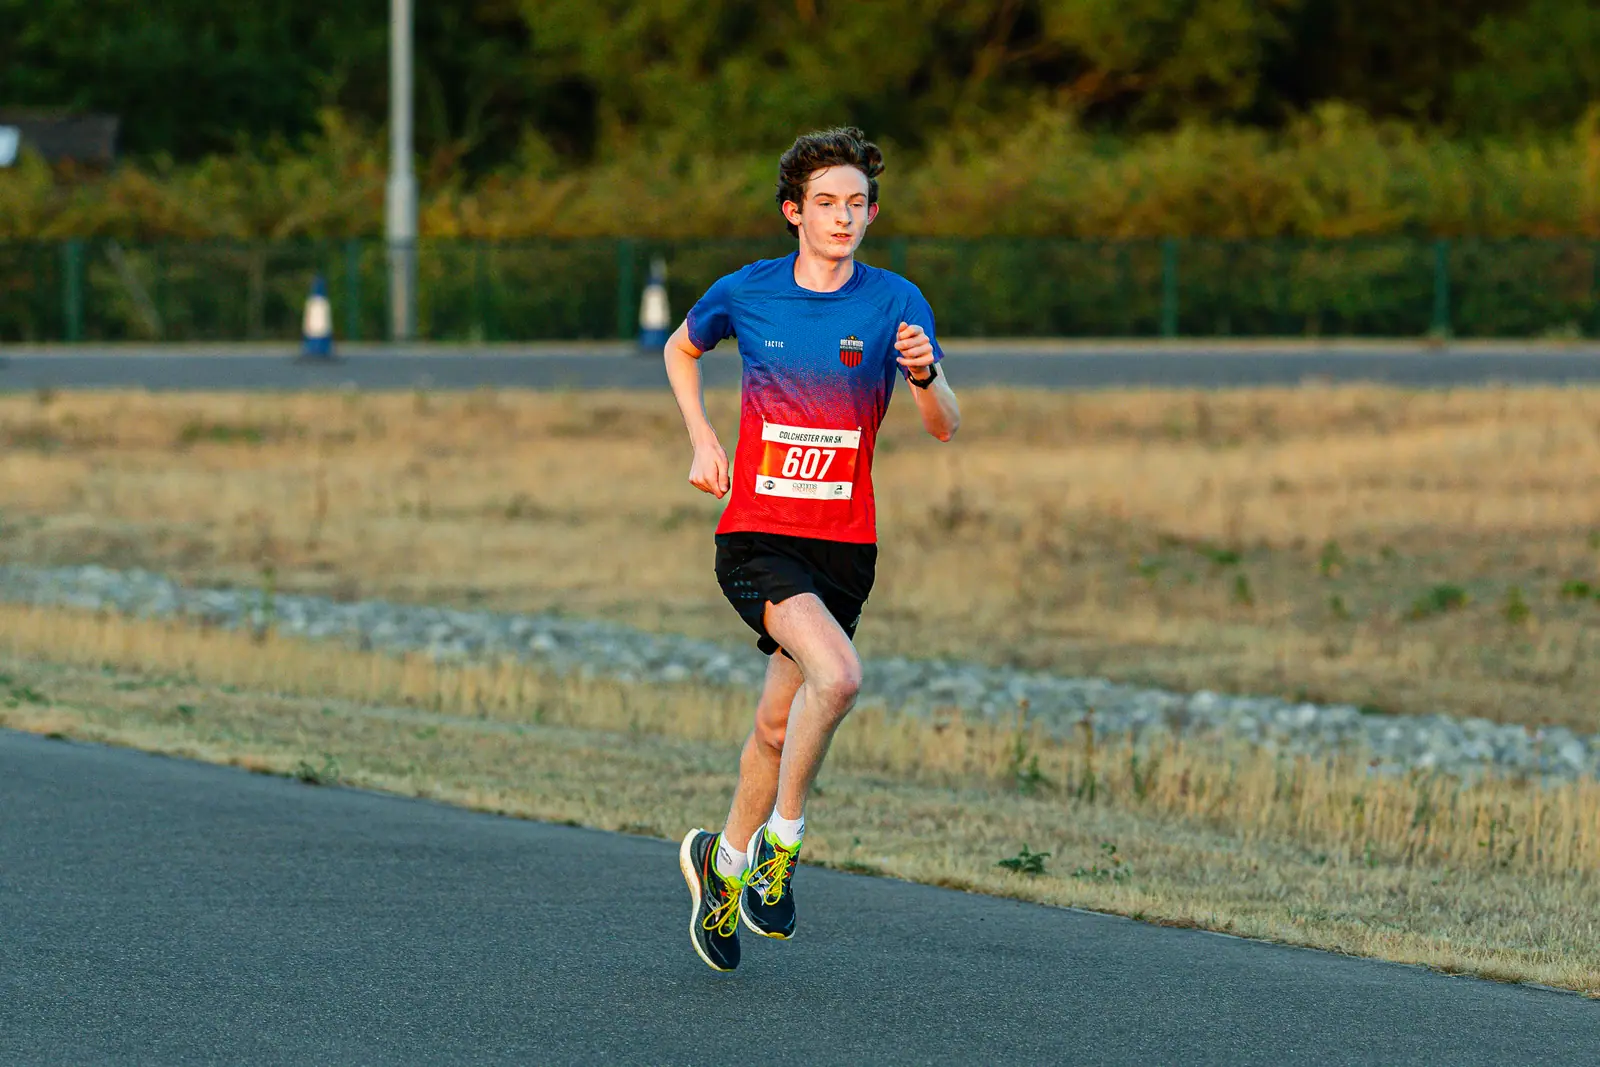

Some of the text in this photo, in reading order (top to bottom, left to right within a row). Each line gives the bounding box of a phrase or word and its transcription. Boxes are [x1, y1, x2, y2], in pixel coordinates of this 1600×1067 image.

[764, 339, 784, 348] TACTIC
[779, 430, 843, 444] COLCHESTER FNR 5K
[781, 446, 837, 480] 607
